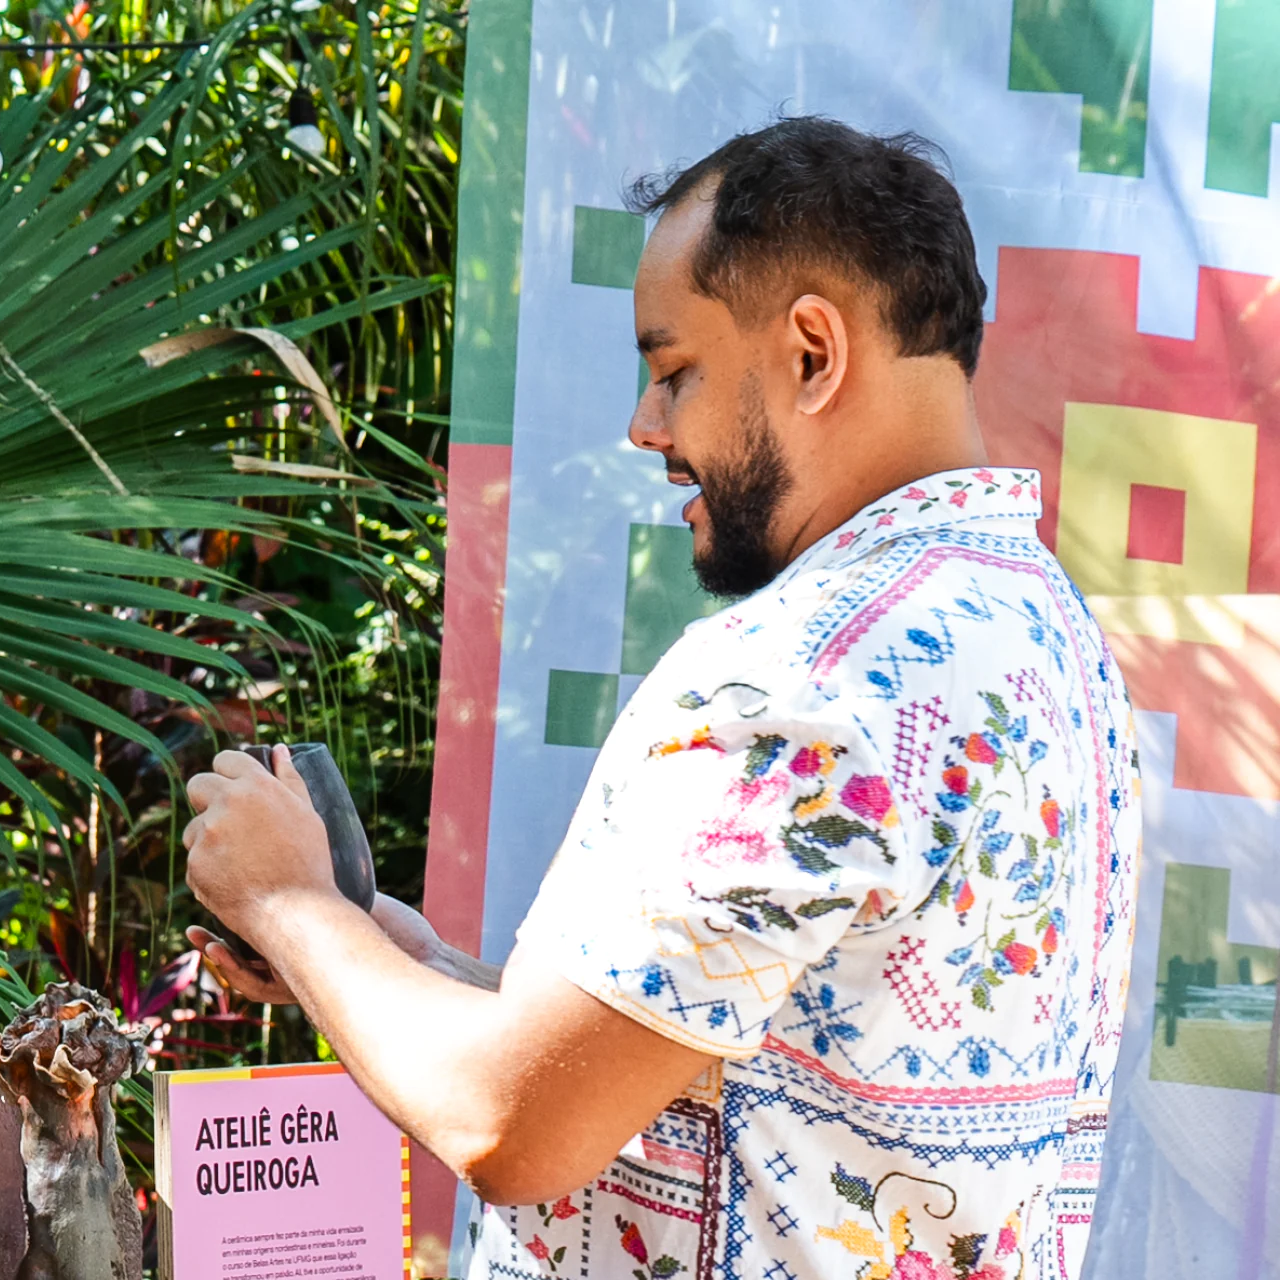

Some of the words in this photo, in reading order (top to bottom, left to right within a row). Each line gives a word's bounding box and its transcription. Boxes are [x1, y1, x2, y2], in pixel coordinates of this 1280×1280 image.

[195, 1106, 271, 1151] ATELIÊ
[280, 1103, 339, 1145] GÊRA
[196, 1155, 319, 1195] QUEIROGA
[228, 1236, 253, 1244] cerâmica
[254, 1234, 275, 1242] sempre
[285, 1232, 300, 1240] parte
[253, 1247, 274, 1255] origens
[275, 1244, 307, 1252] nordestinas
[253, 1260, 269, 1268] Belas
[293, 1255, 312, 1263] UFMG
[337, 1251, 357, 1261] ligação
[318, 1265, 354, 1274] oportunidade
